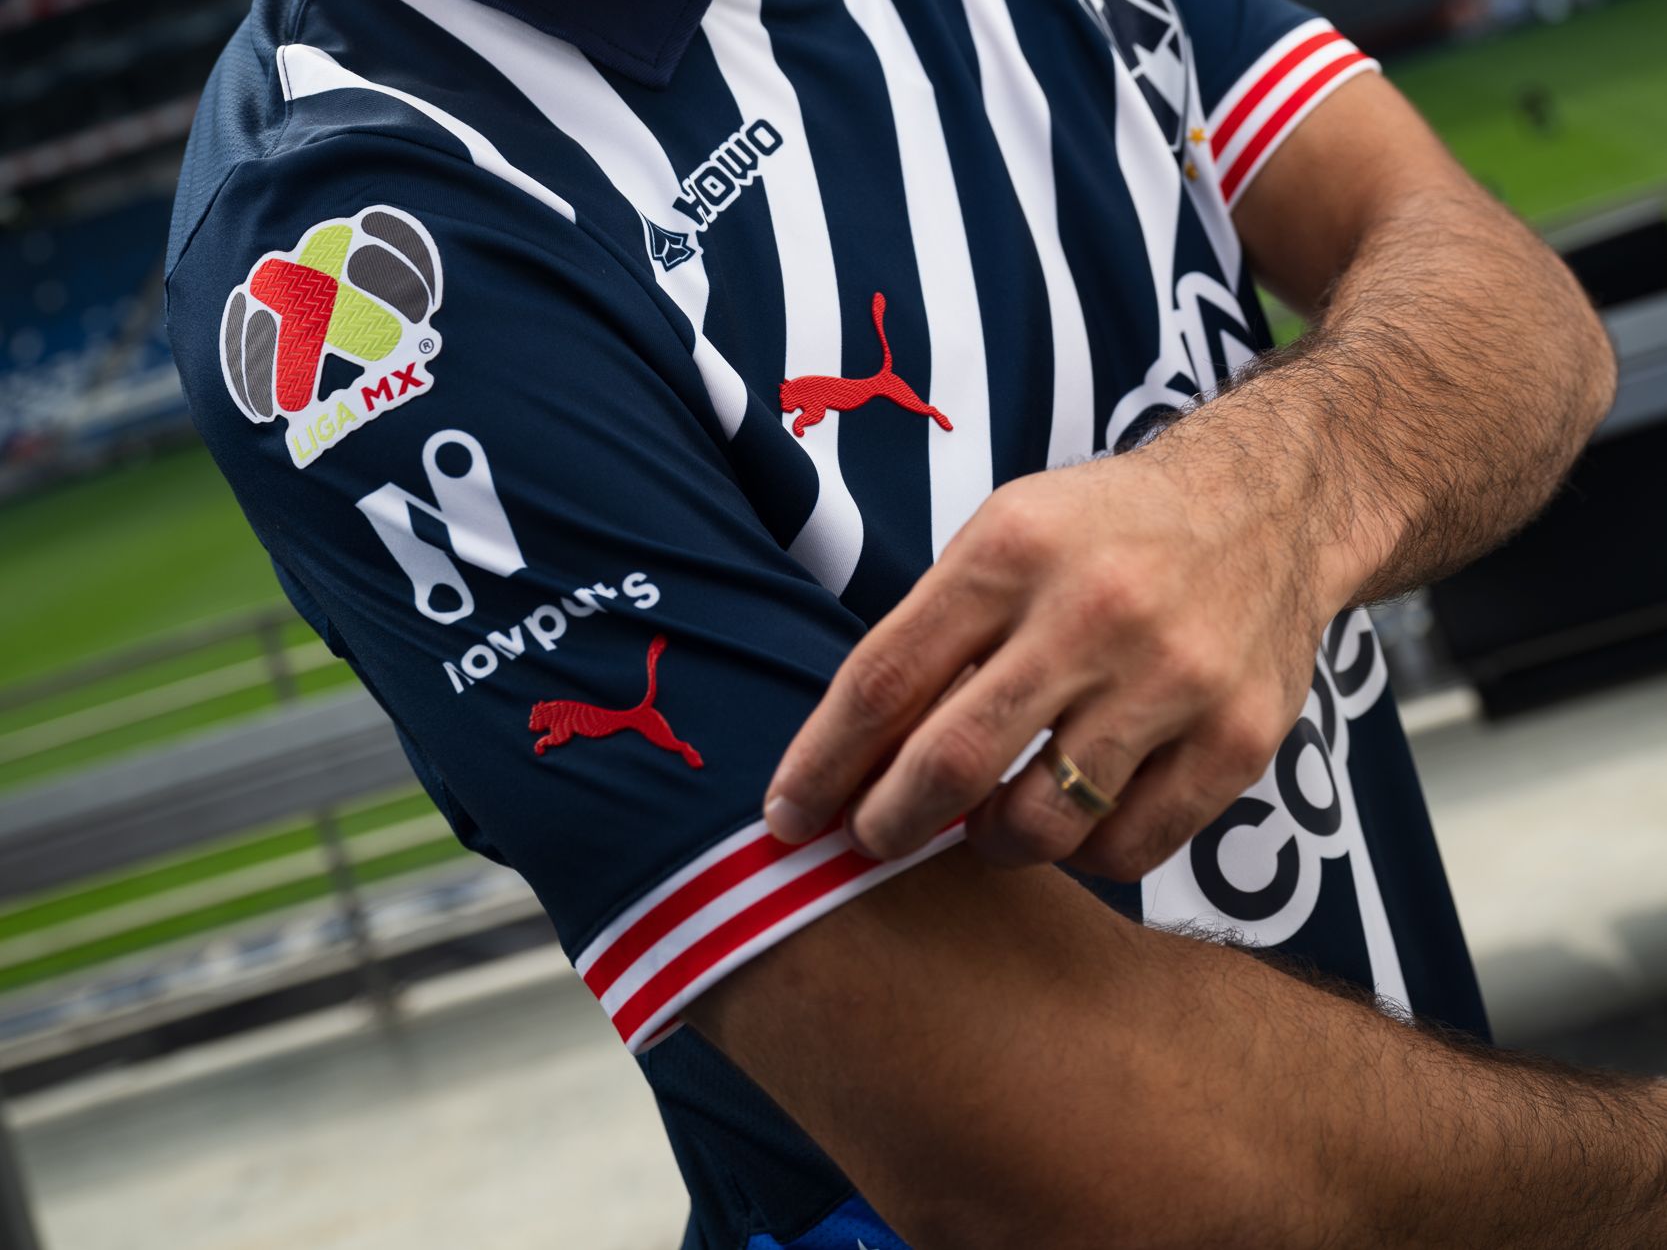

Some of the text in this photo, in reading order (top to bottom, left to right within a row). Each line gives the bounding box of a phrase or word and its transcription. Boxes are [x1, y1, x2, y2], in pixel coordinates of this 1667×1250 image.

[672, 118, 784, 227] HOWO
[291, 361, 425, 462] LIGA MX
[442, 571, 661, 695] novps
